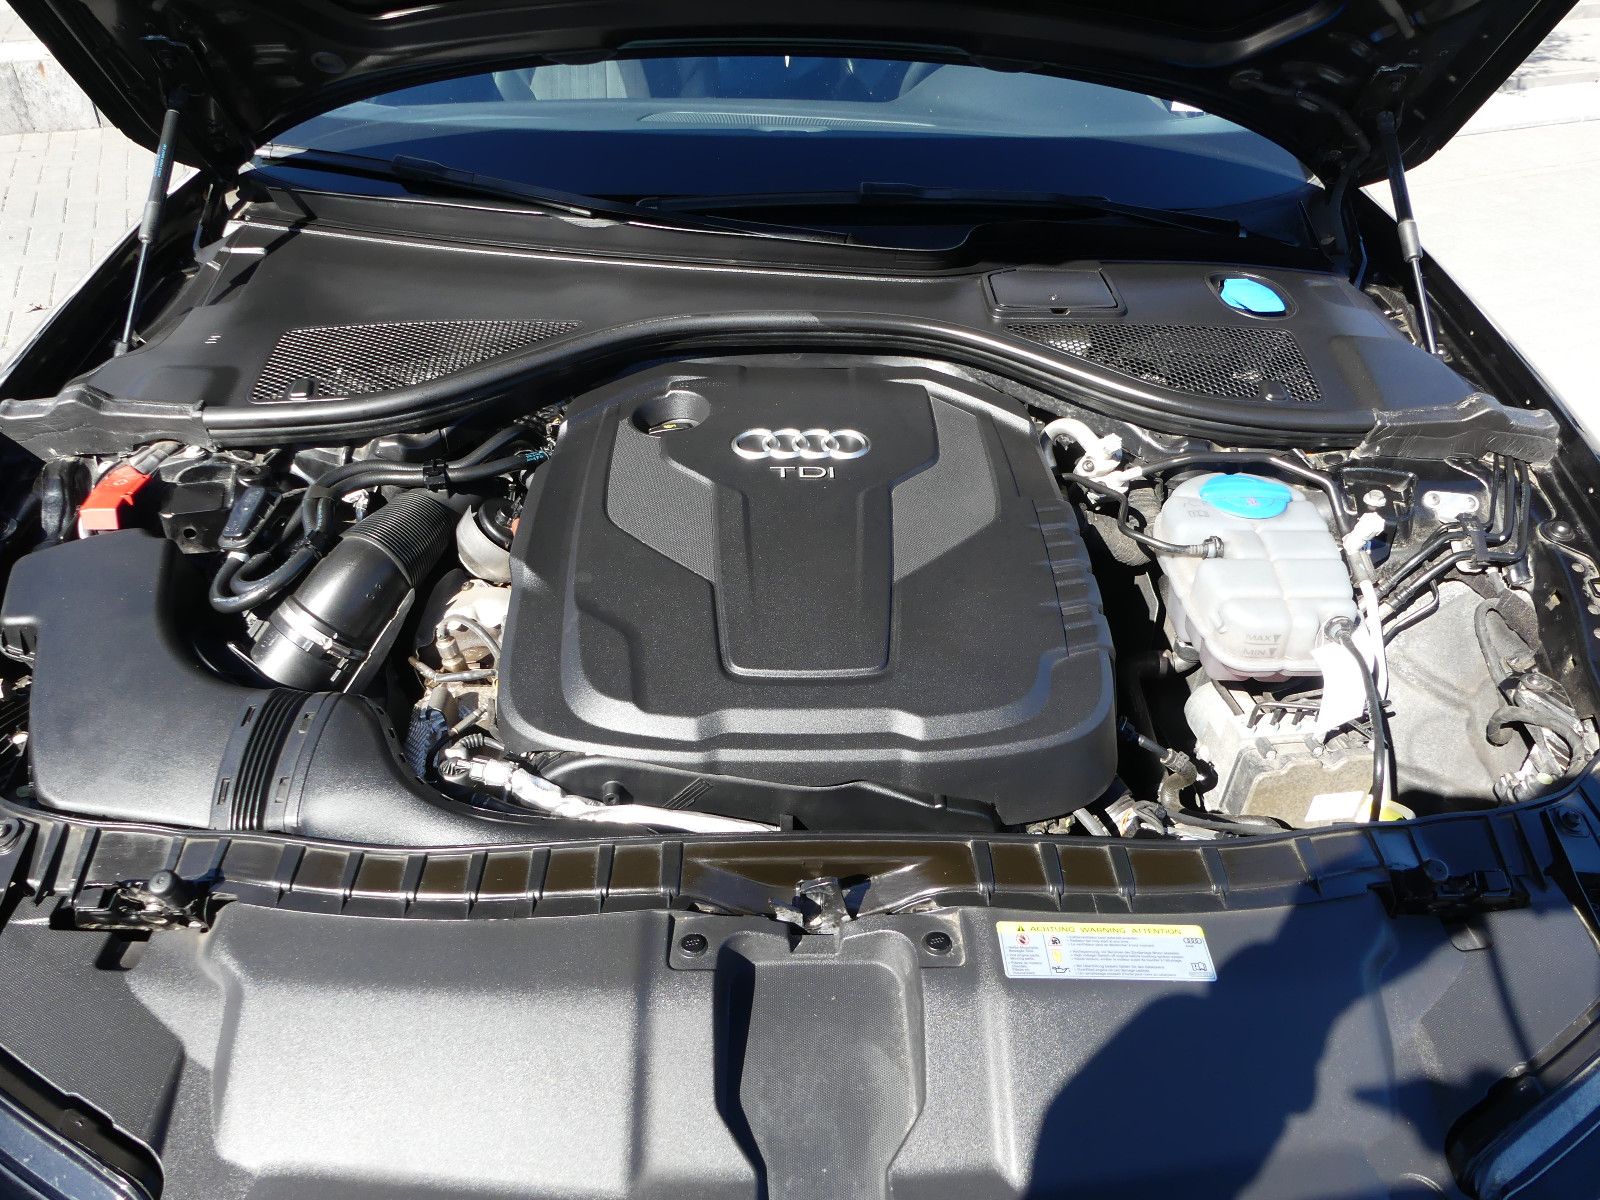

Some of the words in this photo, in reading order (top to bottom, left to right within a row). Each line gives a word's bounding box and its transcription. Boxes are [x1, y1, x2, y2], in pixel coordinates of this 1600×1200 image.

[769, 466, 836, 479] TDI
[1246, 633, 1272, 641] MAX
[1242, 648, 1265, 656] MIN
